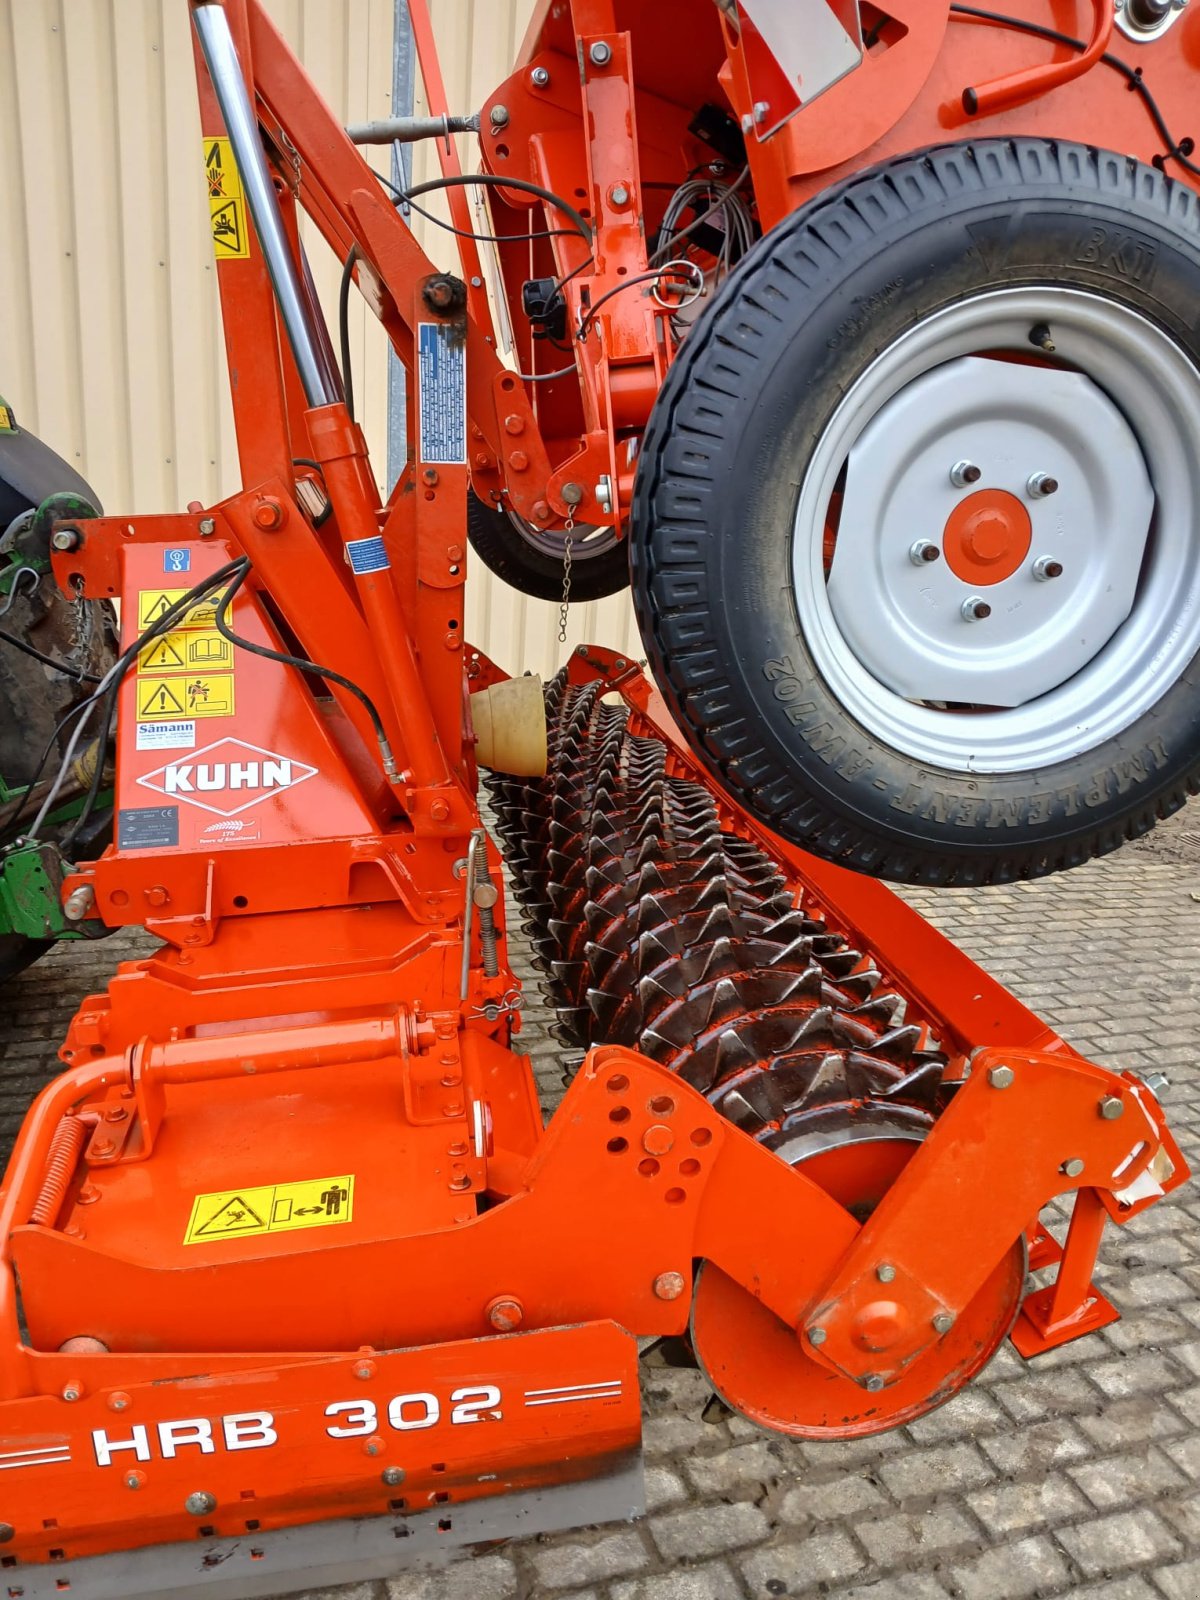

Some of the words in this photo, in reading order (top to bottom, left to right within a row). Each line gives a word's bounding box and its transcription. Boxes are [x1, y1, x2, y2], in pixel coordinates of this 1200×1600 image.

[1073, 226, 1157, 282] BKT
[138, 723, 194, 734] Sämann
[164, 760, 291, 793] KUHN
[888, 735, 1169, 828] IMPLEMENT
[92, 1411, 278, 1466] HRB
[325, 1385, 503, 1438] 302
